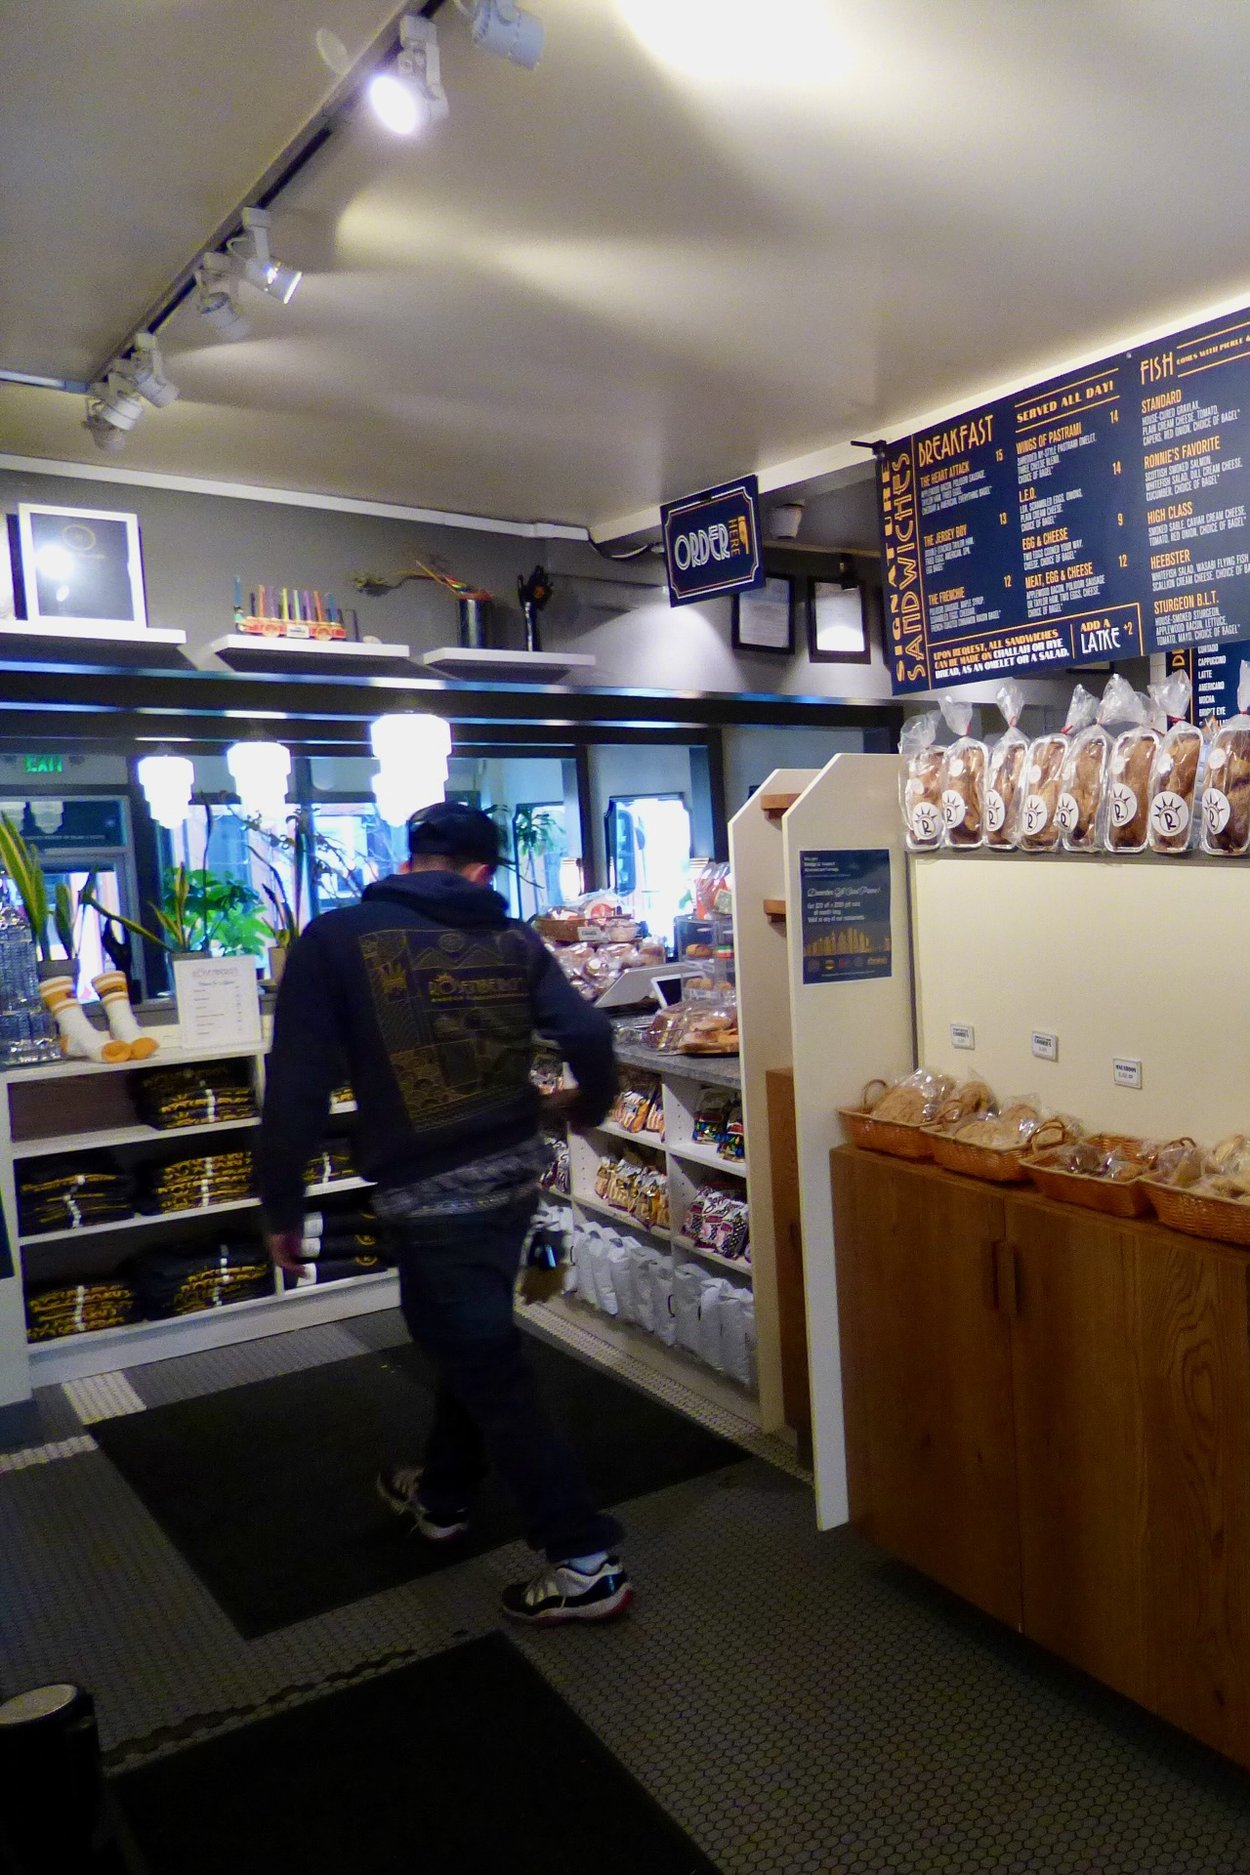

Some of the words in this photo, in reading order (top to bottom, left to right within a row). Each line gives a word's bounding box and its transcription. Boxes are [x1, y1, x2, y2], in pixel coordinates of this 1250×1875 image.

[1140, 352, 1174, 384] FISH
[1016, 400, 1058, 422] SERVED
[1061, 392, 1082, 408] ALL
[1086, 380, 1114, 400] DAY!
[1142, 389, 1182, 414] STANDARD
[918, 414, 994, 468] BREAKFAST
[1016, 438, 1036, 454] WINGS
[1038, 434, 1047, 446] OF
[1048, 422, 1082, 444] PASTRAMI
[1182, 436, 1220, 458] FAVORITE
[1148, 508, 1166, 524] HIGH
[1168, 502, 1193, 519] CLASS
[675, 523, 730, 570] ORDER
[728, 519, 740, 556] HERE
[892, 453, 926, 681] SANDWICHES
[1151, 549, 1190, 570] HEEBSTER
[1154, 595, 1194, 614] STURGEON
[1198, 591, 1219, 605] B.L.T.
[1081, 628, 1120, 654] LATKE
[1198, 670, 1212, 680] LATTE
[25, 755, 62, 773] EXIT
